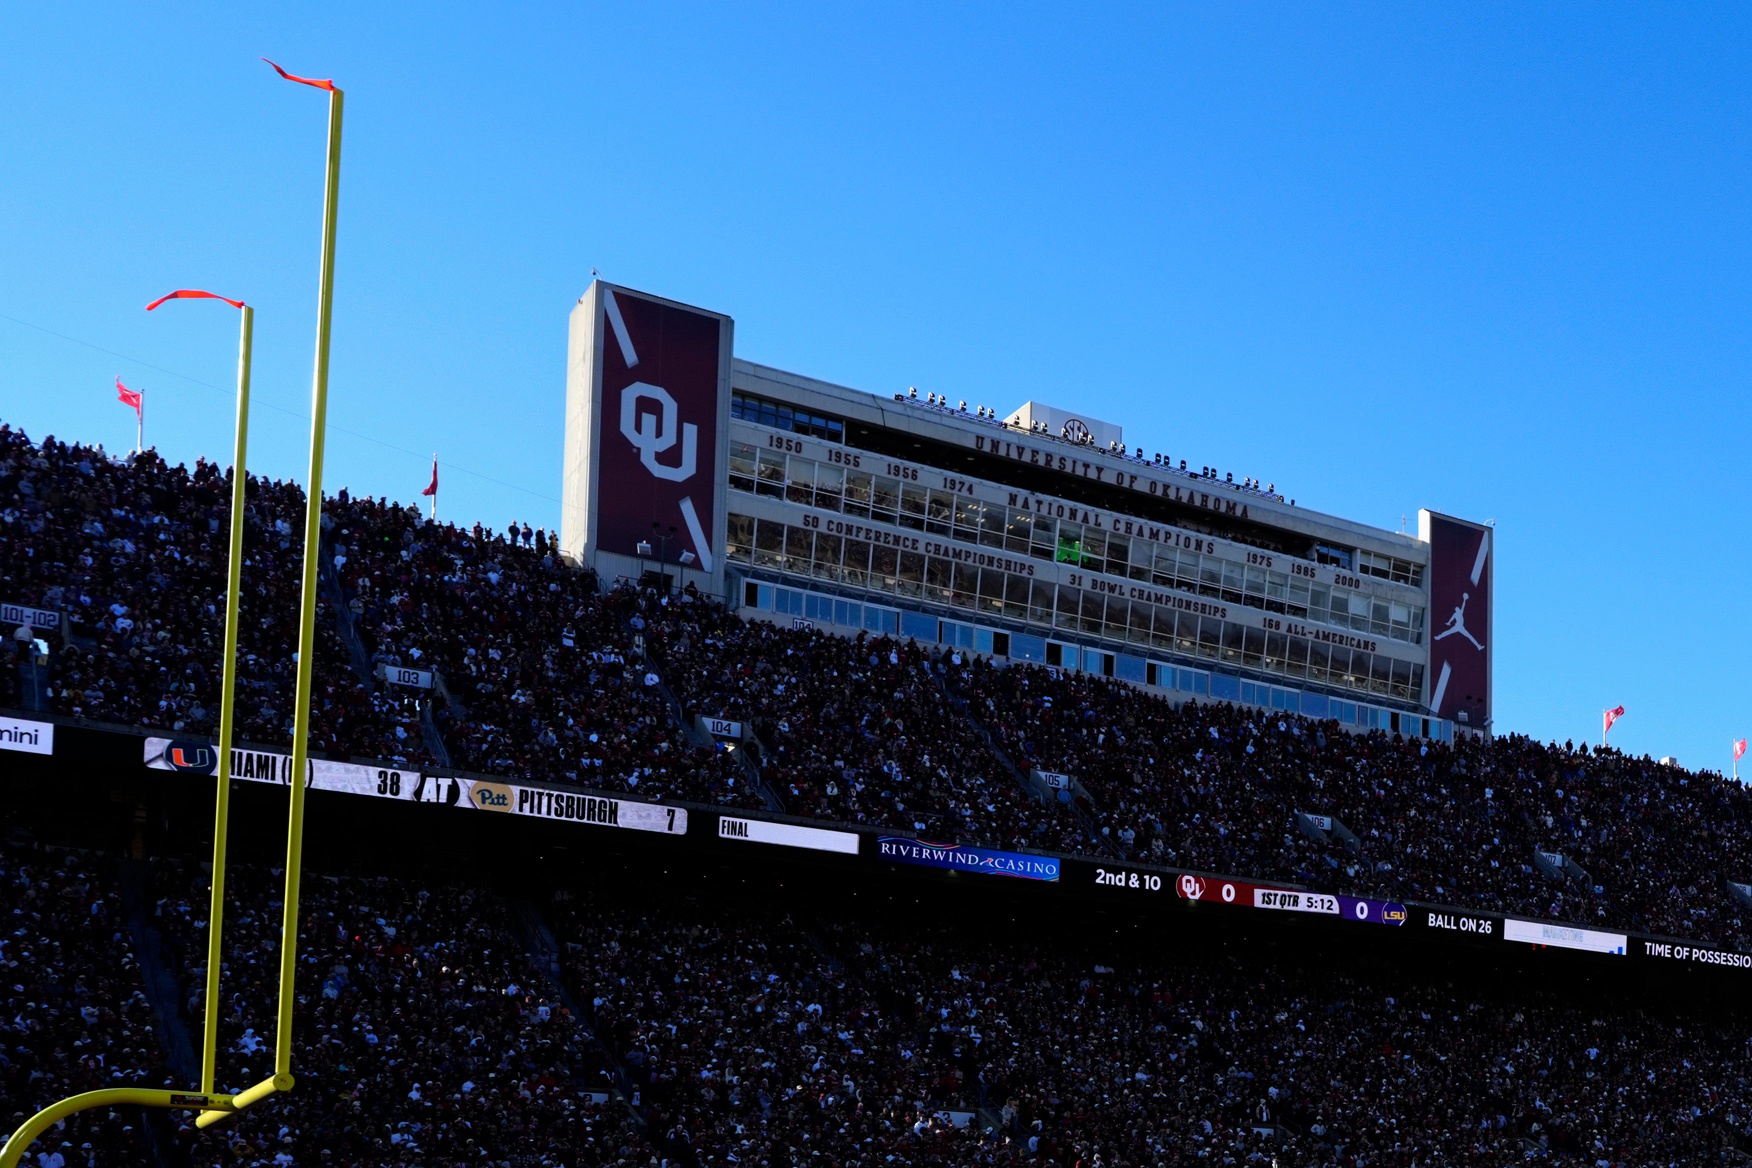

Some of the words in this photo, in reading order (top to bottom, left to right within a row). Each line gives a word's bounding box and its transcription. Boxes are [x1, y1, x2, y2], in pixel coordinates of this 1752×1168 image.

[620, 381, 698, 483] OU
[975, 435, 1104, 480] UNIVERSITY
[1116, 472, 1139, 489] OF
[1149, 480, 1249, 519] OKLAHOMA
[768, 434, 803, 455] 1950
[827, 448, 861, 468] 1955
[886, 463, 919, 481] 1956
[942, 476, 975, 496] 1974
[1007, 492, 1102, 527] NATIONAL
[1113, 519, 1215, 555] CHAMPIONS
[1246, 552, 1272, 568] 1975
[1291, 562, 1316, 578] 1985
[1334, 573, 1361, 589] 2000
[803, 514, 820, 528] 50
[827, 519, 919, 551] CONFERENCE
[925, 541, 1035, 576] CHAMPIONSHIPS
[1069, 574, 1083, 587] 31
[1090, 579, 1125, 597] BOWL
[1129, 587, 1227, 619] CHAMPIONSHIPS
[3, 605, 58, 625] 101-102
[1262, 617, 1281, 631] 168
[1286, 622, 1377, 652] ALL-AMERICANS
[397, 670, 419, 685] 103
[711, 720, 732, 735] 104
[377, 770, 401, 797] 38
[421, 777, 452, 804] AT
[1044, 773, 1060, 787] 105
[475, 788, 509, 807] Pitt
[518, 789, 619, 825] PITTSBURGH
[667, 809, 675, 832] 7
[721, 819, 749, 837] FINAL
[881, 843, 979, 865] RIVERWIND
[994, 857, 1057, 875] CASINO
[1095, 869, 1126, 887] 2nd
[1128, 873, 1140, 888] &
[1143, 875, 1161, 890] 10
[1181, 875, 1202, 899] OU
[1221, 884, 1236, 902] 0
[1261, 893, 1279, 906] 1ST
[1279, 894, 1299, 908] QTR
[1306, 896, 1334, 911] 5:12
[1355, 902, 1369, 919] 0
[1384, 910, 1405, 921] LSU
[1428, 913, 1457, 930] BALL
[1459, 917, 1477, 932] ON
[1478, 920, 1492, 934] 26
[1645, 942, 1672, 958] TIME
[1674, 946, 1690, 960] OF
